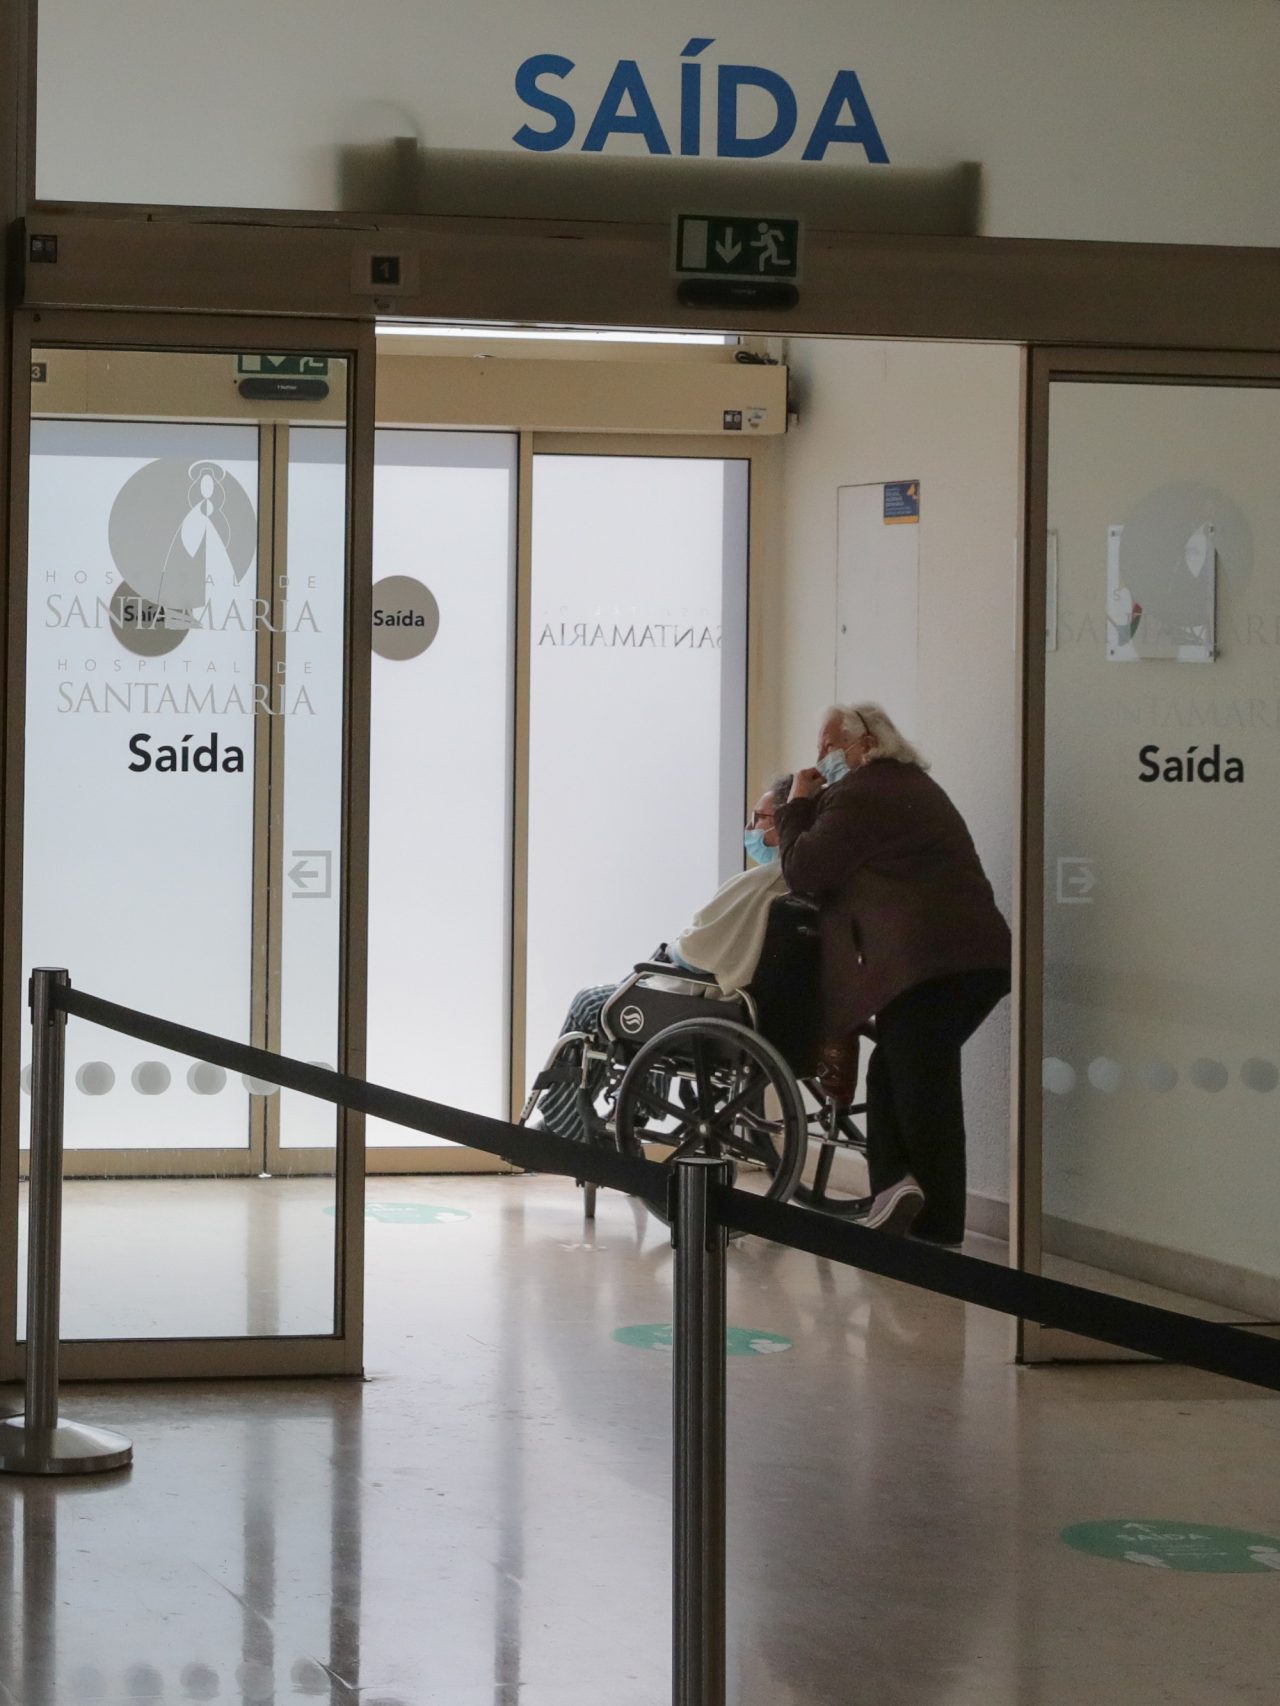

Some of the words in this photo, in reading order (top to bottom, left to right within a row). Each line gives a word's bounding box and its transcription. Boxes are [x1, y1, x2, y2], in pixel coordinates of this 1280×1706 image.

[512, 38, 890, 164] SAÍDA
[373, 608, 425, 627] Saída
[57, 658, 241, 673] HOSPITAL
[275, 660, 314, 675] DE
[56, 681, 318, 716] SANTAMARIA
[127, 732, 245, 773] Saída
[1138, 743, 1245, 783] Saída
